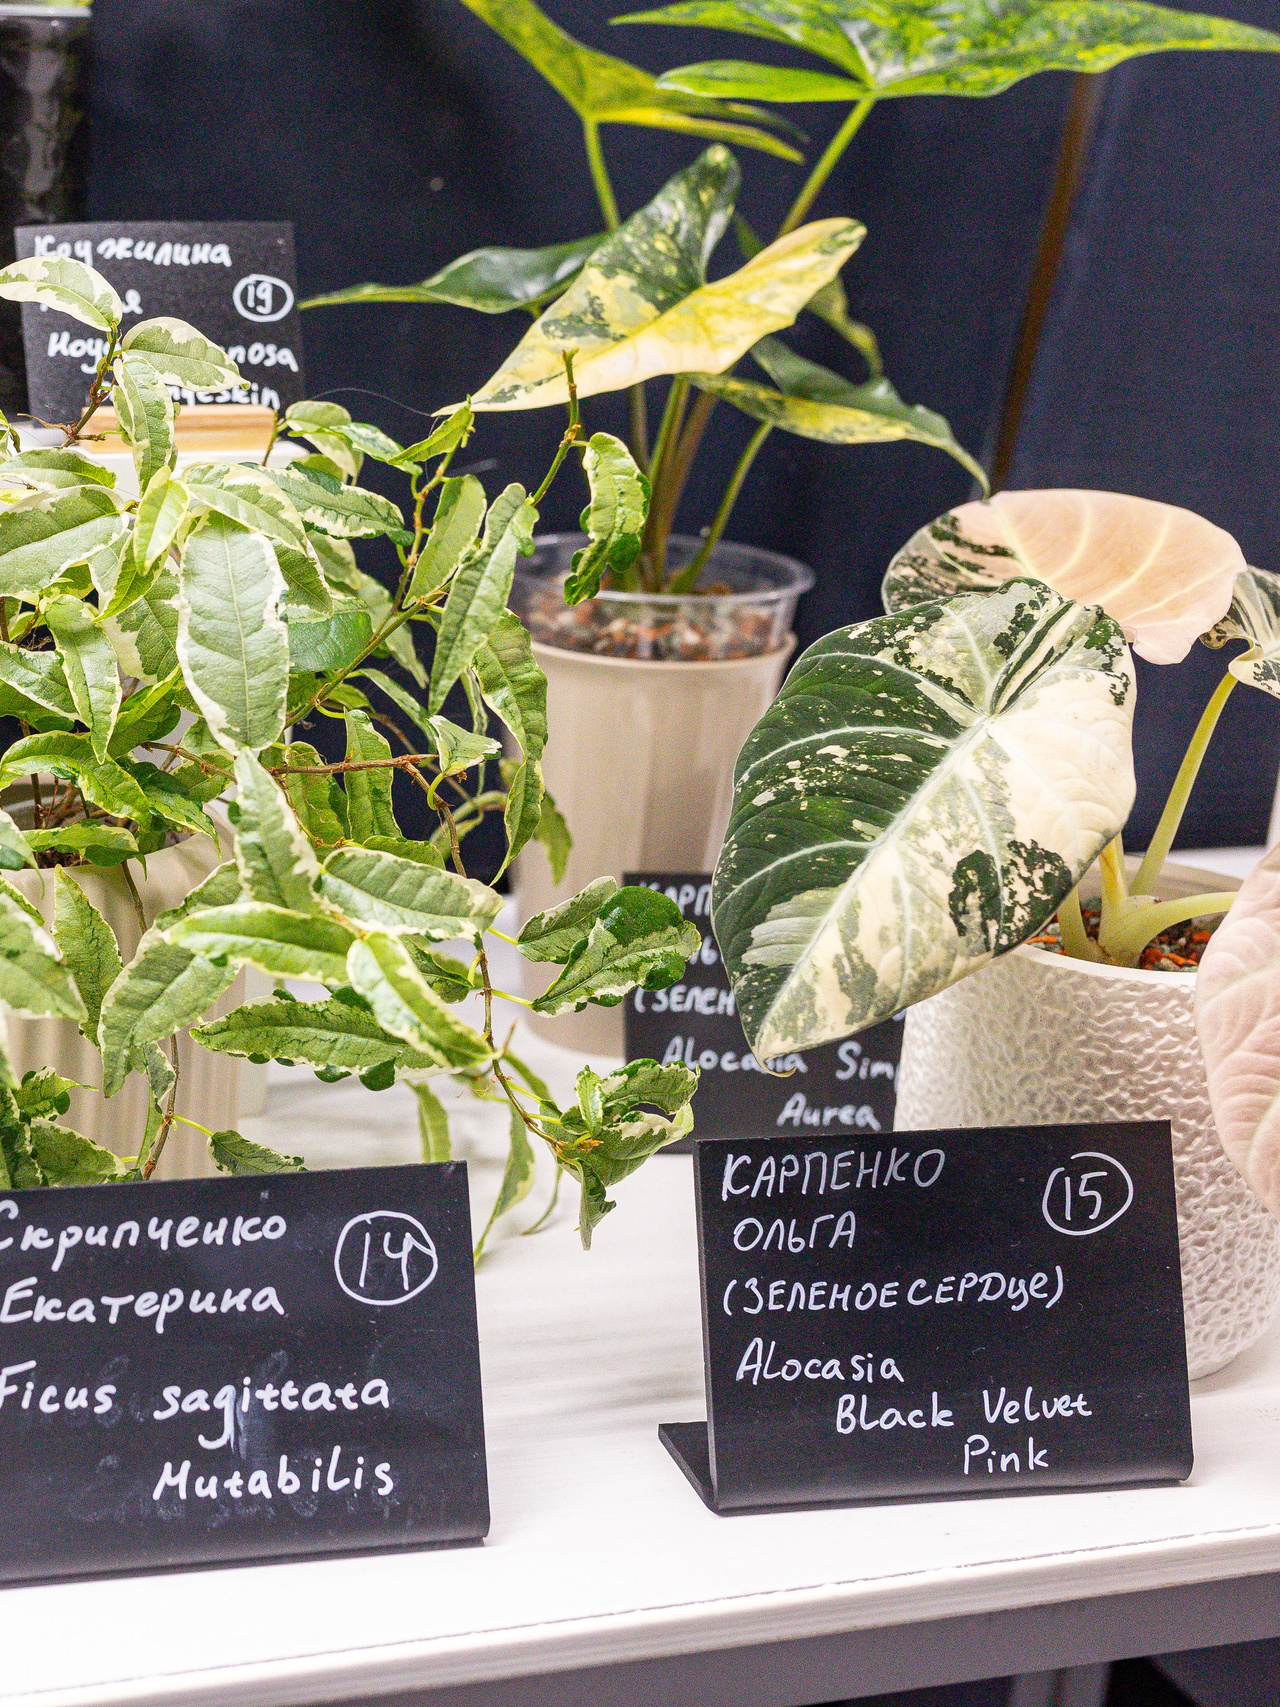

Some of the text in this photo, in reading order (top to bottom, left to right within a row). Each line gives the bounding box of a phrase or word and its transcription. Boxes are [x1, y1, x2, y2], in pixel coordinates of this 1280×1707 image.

[247, 282, 272, 314] 19
[222, 342, 299, 372] nosa
[835, 1041, 899, 1093] Sim
[777, 1093, 880, 1130] Aurea
[722, 1148, 945, 1202] КАРПЕНКО
[1062, 1170, 1108, 1221] 15
[734, 1211, 855, 1253] ОЛЬГА
[359, 1231, 413, 1291] 14
[0, 1277, 284, 1333] Екатерина
[154, 1377, 390, 1450] sagittata
[983, 1387, 1093, 1424] Velvet
[964, 1434, 1049, 1475] Pink
